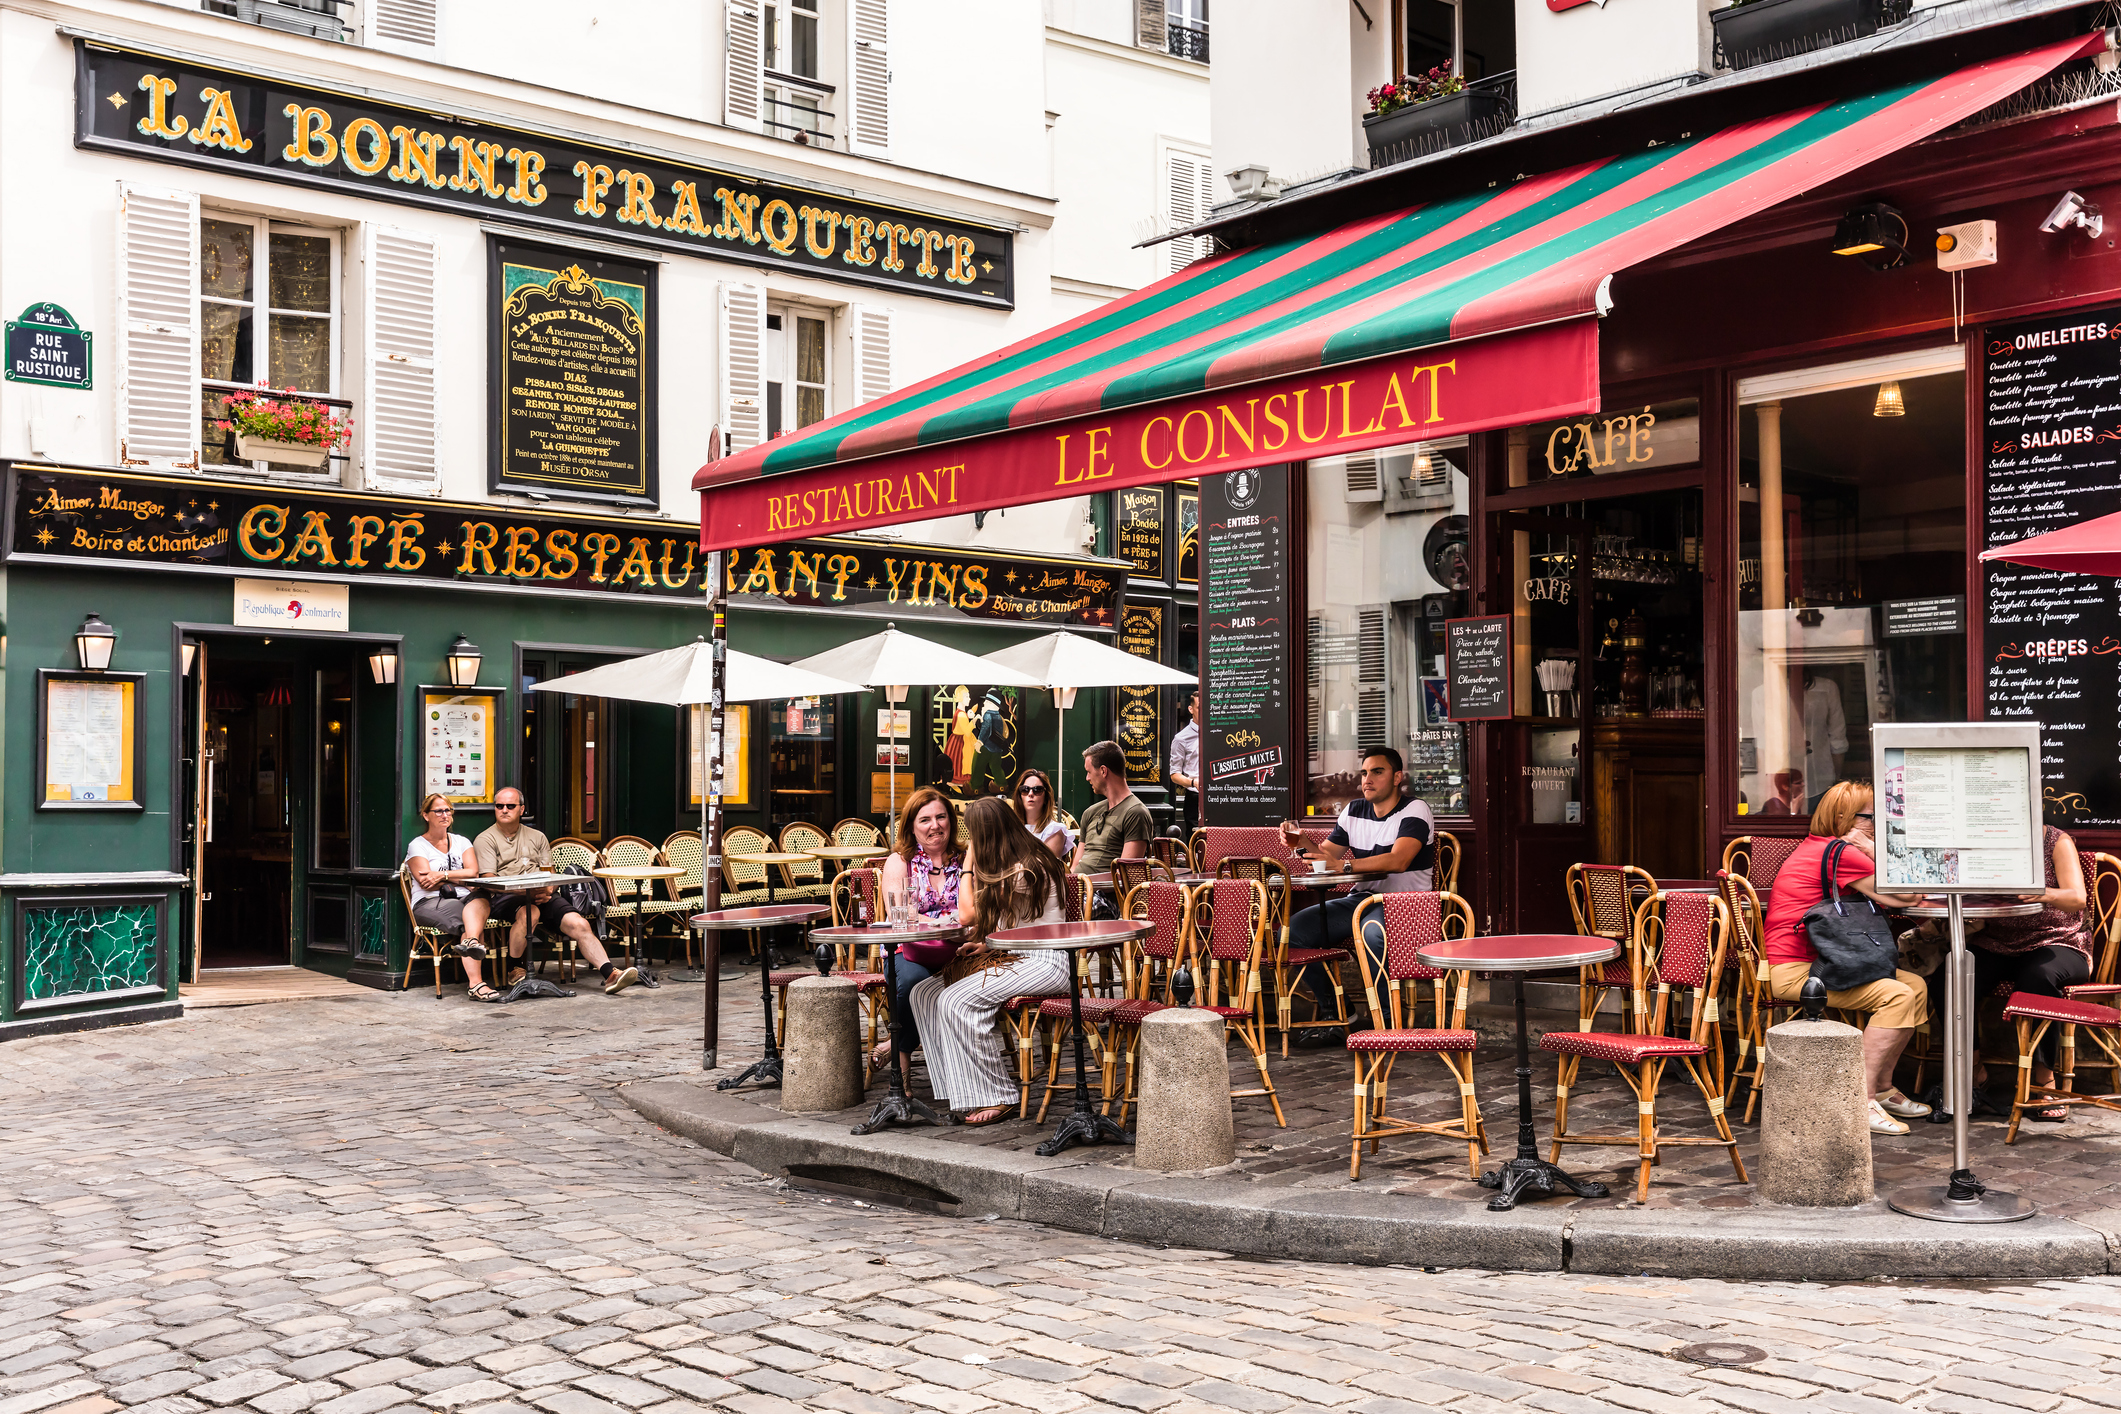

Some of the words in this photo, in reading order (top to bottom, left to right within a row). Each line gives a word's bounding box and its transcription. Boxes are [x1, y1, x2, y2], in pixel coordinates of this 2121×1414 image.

[137, 73, 253, 154] LA
[281, 103, 548, 207] BONNE
[573, 160, 977, 285] FRANQUETTE
[560, 298, 578, 306] Depuis
[579, 300, 591, 308] 1925
[512, 322, 530, 337] LA
[528, 310, 567, 326] BONNE
[570, 309, 636, 354] FRANQUETTE
[545, 325, 604, 343] Anciennement
[2015, 322, 2108, 350] OMELETTES
[36, 333, 62, 348] RUE
[30, 347, 69, 363] SAINT
[511, 340, 530, 350] Cette
[531, 344, 559, 357] auberge
[560, 348, 571, 356] est
[572, 351, 596, 361] célèbre
[598, 354, 620, 365] depuis
[622, 357, 637, 366] 1890
[16, 360, 81, 379] RUSTIQUE
[512, 351, 557, 367] Rendez-vous
[558, 359, 590, 372] d'artistes,
[591, 363, 603, 373] elle
[609, 366, 636, 378] accueilli
[1990, 360, 2022, 371] Omelette
[2024, 354, 2057, 368] complète
[564, 372, 587, 383] DIAZ
[1989, 372, 2022, 384] Omelette
[2025, 369, 2047, 379] mixte
[1989, 386, 2022, 398] Omelette
[2024, 383, 2058, 397] fromage
[2070, 374, 2119, 388] champignons
[1990, 400, 2022, 412] Omelette
[2025, 395, 2074, 408] champignons
[512, 408, 528, 417] SON
[529, 410, 555, 421] JARDIN
[560, 414, 585, 424] SERVIT
[587, 417, 597, 425] DE
[600, 418, 629, 430] MODÈLE
[631, 421, 636, 430] À
[530, 430, 549, 439] pour
[550, 432, 563, 440] son
[565, 434, 592, 444] tableau
[594, 437, 620, 447] célèbre
[766, 463, 966, 533] RESTAURANT
[1054, 427, 1115, 487] LE
[1140, 357, 1457, 470] CONSULAT
[1545, 404, 1656, 475] CAFÉ
[2021, 426, 2094, 449] SALADES
[515, 449, 530, 458] Peint
[538, 452, 558, 461] octobre
[578, 456, 596, 466] exposé
[597, 459, 626, 469] maintenant
[1989, 458, 2016, 469] Salade
[2031, 453, 2063, 465] Consulat
[541, 461, 571, 474] MUSÉE
[572, 467, 610, 478] D'ORSAY
[1989, 484, 2015, 493] Salade
[29, 488, 95, 514] Aimer,
[99, 486, 165, 520] Manger,
[1124, 493, 1156, 510] Maison
[1989, 505, 2018, 516] Salade
[2021, 504, 2032, 512] de
[2034, 500, 2065, 512] volaille
[1122, 510, 1159, 531] Fondée
[1227, 515, 1259, 528] ENTRÉES
[71, 528, 123, 551] Boire
[127, 535, 147, 553] et
[148, 528, 229, 552] Chanter!!!
[1121, 532, 1131, 542] En
[1132, 534, 1149, 543] 1925
[1150, 534, 1160, 544] de
[1989, 529, 2018, 542] Salade
[238, 503, 427, 572] CAFÉ
[883, 557, 990, 609] VINS
[1131, 544, 1150, 558] PÈRE
[1133, 560, 1149, 570] FILS
[1523, 577, 1571, 605] CAFÉ
[1990, 587, 2017, 601] Croque
[2019, 586, 2058, 595] madame,
[2058, 585, 2075, 595] garni
[2078, 583, 2098, 591] salade
[242, 599, 285, 618] République
[992, 595, 1023, 612] Boire
[1026, 600, 1038, 613] et
[1990, 600, 2027, 614] Spaghetti
[2030, 597, 2071, 611] bolognaise
[2074, 596, 2104, 604] maison
[1232, 617, 1255, 628] PLATS
[1989, 614, 2022, 624] Assiette
[2024, 614, 2033, 622] de
[2036, 613, 2042, 621] 3
[2042, 612, 2080, 626] fromages
[1453, 627, 1463, 635] LES
[1483, 624, 1502, 632] CARTE
[2025, 638, 2088, 657] CRÊPES
[2006, 667, 2027, 675] sucre
[1470, 685, 1487, 696] frites
[2000, 678, 2009, 687] la
[2010, 677, 2043, 691] confiture
[2046, 677, 2055, 685] de
[2057, 677, 2079, 689] fraise
[1233, 690, 1251, 698] canard
[2005, 706, 2033, 715] Nutella
[1411, 732, 1421, 740] LES
[1423, 730, 1440, 740] PÂTES
[1442, 731, 1451, 739] EN
[2042, 738, 2064, 747] rhum
[1213, 757, 1246, 774] L'ASSIETTE
[1250, 750, 1275, 765] MIXTE
[2041, 755, 2064, 763] citron
[1522, 765, 1575, 777] RESTAURANT
[1532, 780, 1565, 791] OUVERT
[1220, 795, 1229, 804] pork
